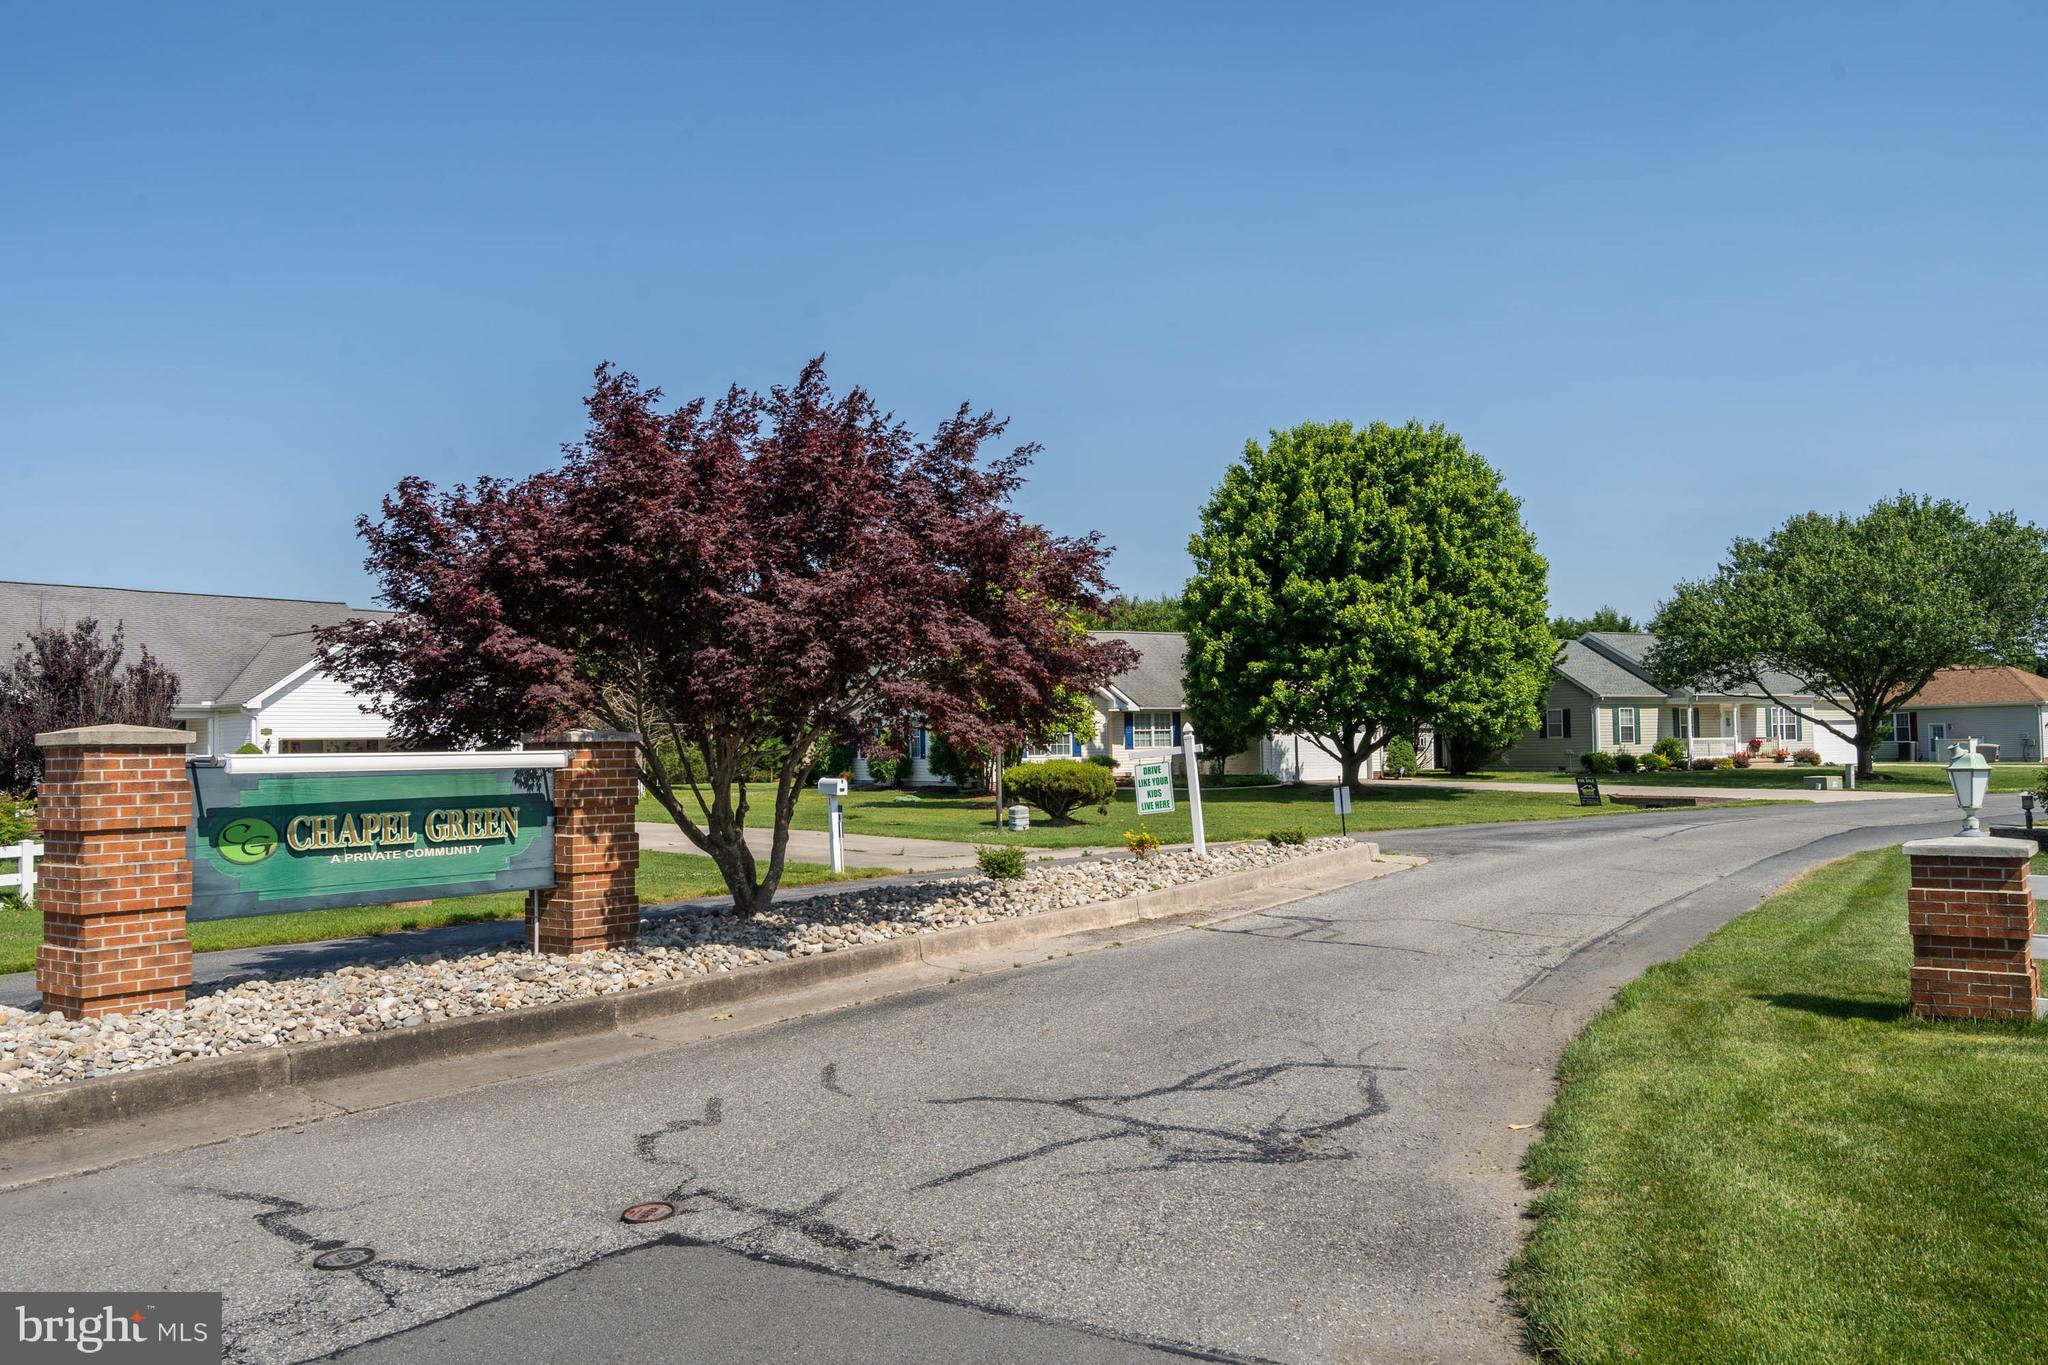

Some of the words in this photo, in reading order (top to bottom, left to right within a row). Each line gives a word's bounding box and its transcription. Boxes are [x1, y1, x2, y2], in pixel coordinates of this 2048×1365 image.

[1143, 766, 1161, 775] DRIVE
[1138, 778, 1150, 787] LIKE
[1152, 776, 1168, 786] YOUR
[1147, 789, 1162, 798] KIDS
[1141, 802, 1154, 810] LIVE
[1155, 800, 1170, 808] HERE
[286, 811, 418, 852] CHAPEL
[424, 806, 520, 843] GREEN
[223, 824, 273, 857] CG
[330, 854, 341, 864] A
[344, 850, 402, 863] PRIVATE
[404, 845, 482, 858] COMMUNITY
